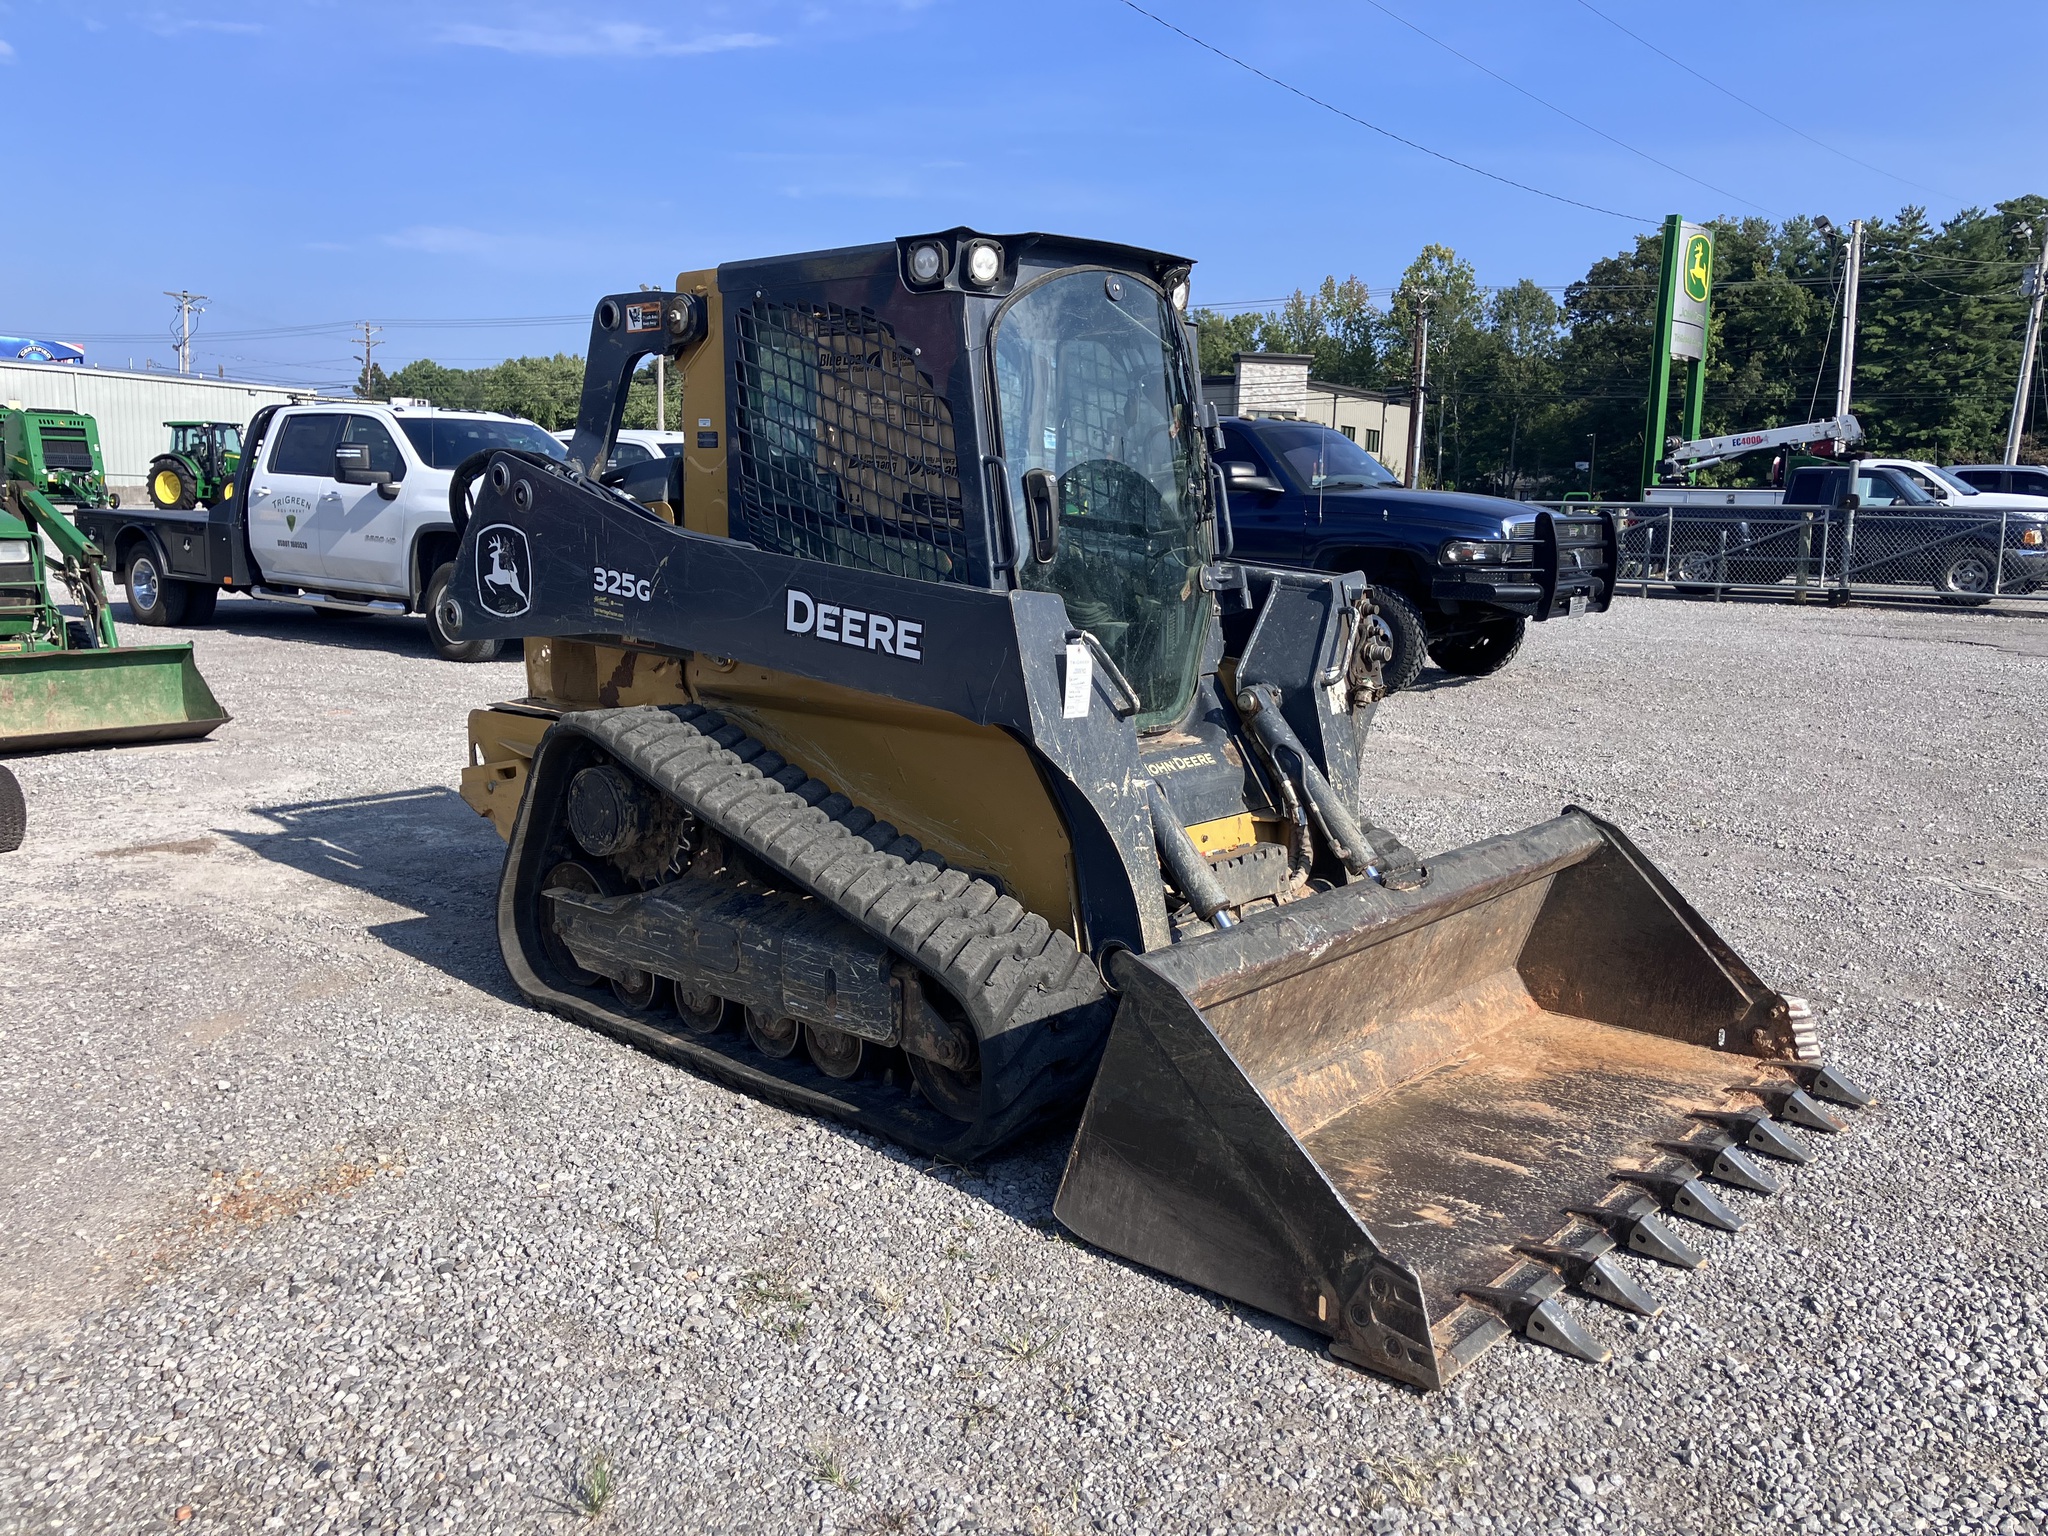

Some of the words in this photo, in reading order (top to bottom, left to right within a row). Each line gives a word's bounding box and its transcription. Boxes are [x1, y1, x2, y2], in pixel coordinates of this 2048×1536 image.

[20, 346, 52, 359] CERTIFIED
[1732, 436, 1762, 446] EC4000
[272, 495, 312, 510] TRIGREEN
[277, 539, 290, 548] USDOT
[593, 567, 650, 602] 325G
[787, 589, 922, 660] DEERE
[1173, 753, 1217, 770] DEERE
